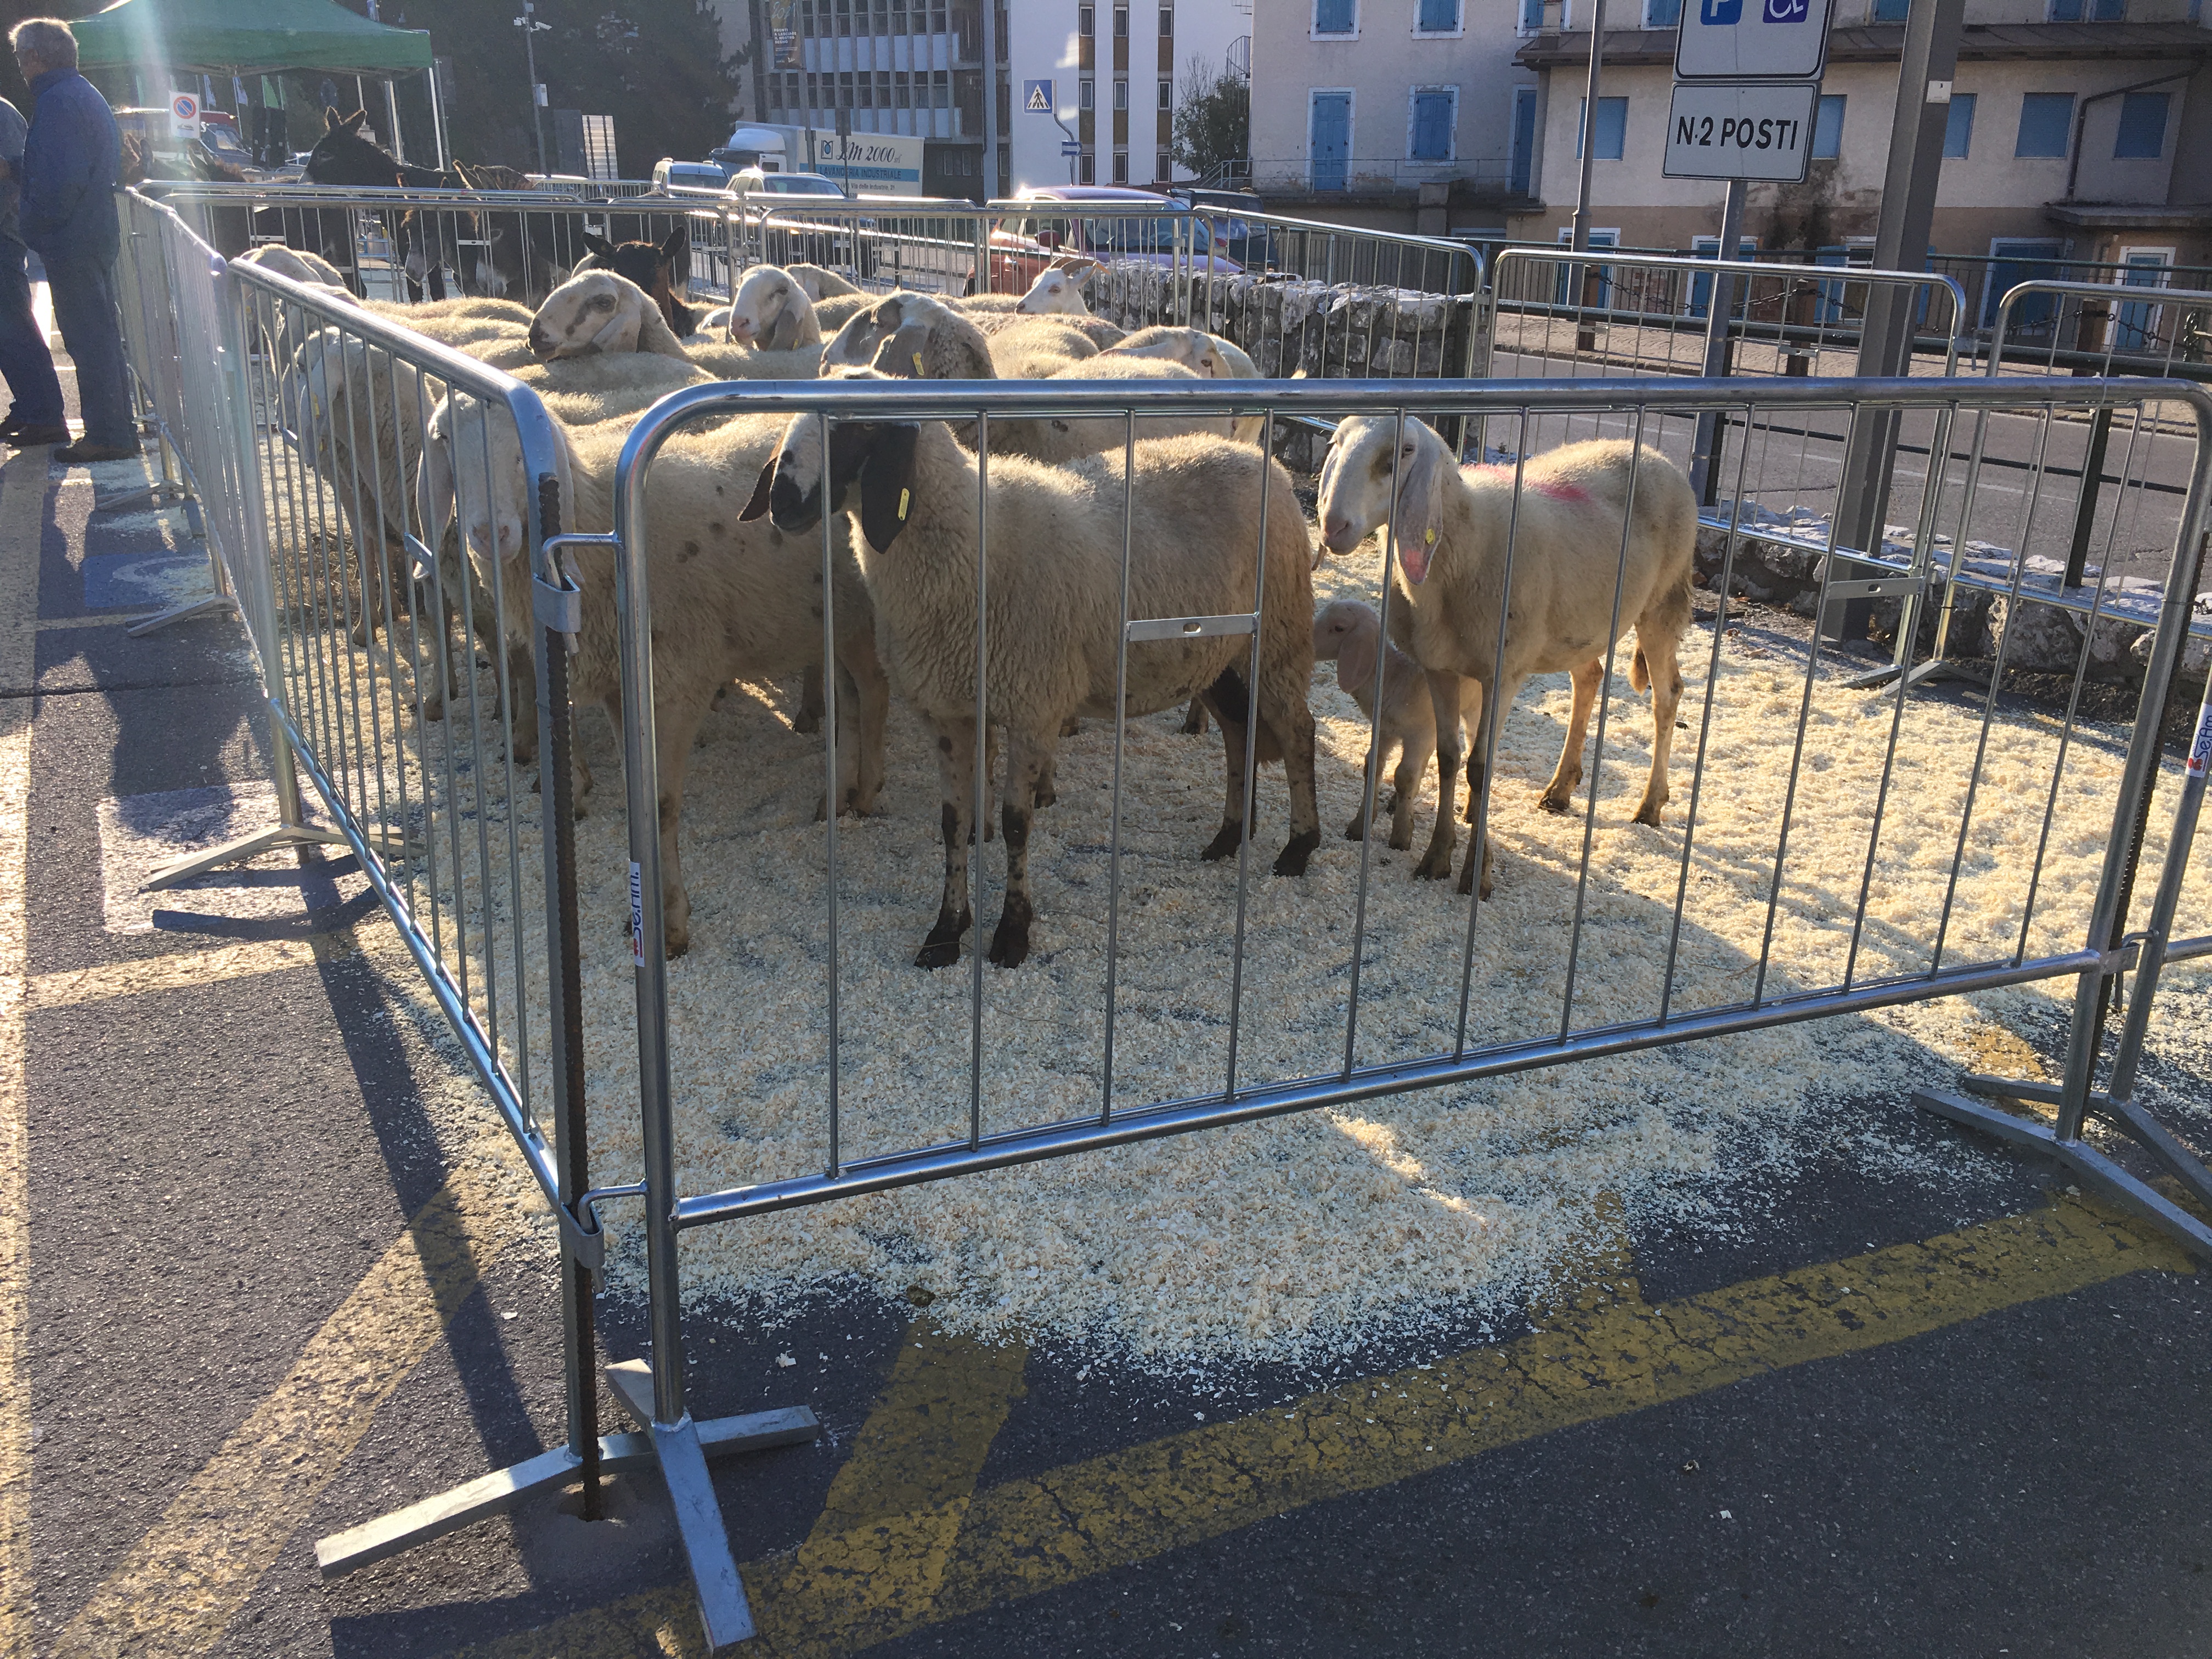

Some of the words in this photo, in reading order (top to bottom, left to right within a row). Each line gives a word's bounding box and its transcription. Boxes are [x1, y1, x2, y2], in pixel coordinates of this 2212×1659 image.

[1720, 118, 1798, 150] POSTI
[865, 146, 895, 163] 2000
[861, 169, 901, 179] INDUSTRIALE
